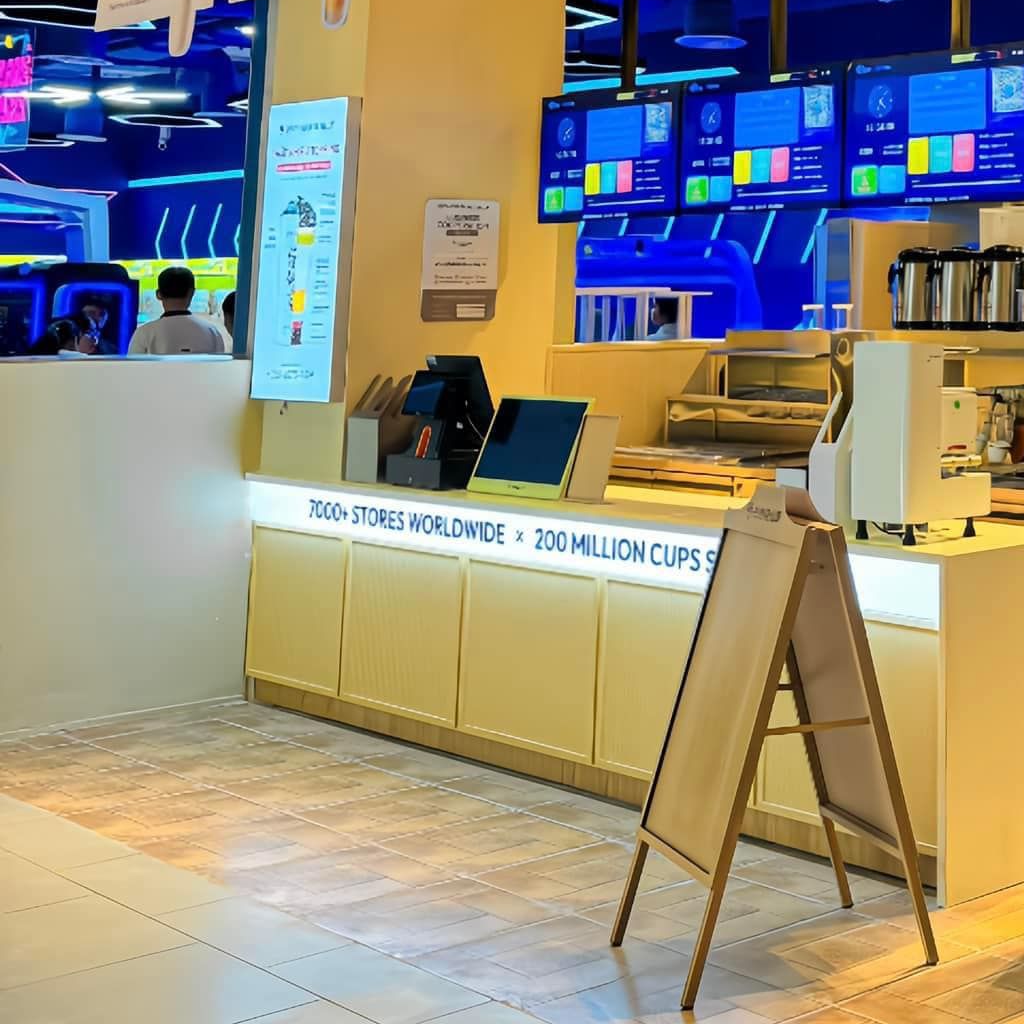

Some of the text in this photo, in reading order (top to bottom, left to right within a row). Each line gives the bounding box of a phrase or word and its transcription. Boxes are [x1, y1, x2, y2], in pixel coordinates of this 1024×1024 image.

[351, 505, 404, 531] STORES
[409, 512, 505, 544] WORLDWIDE
[534, 528, 567, 552] 200
[571, 532, 646, 564] MILLION
[650, 542, 701, 572] CUPS
